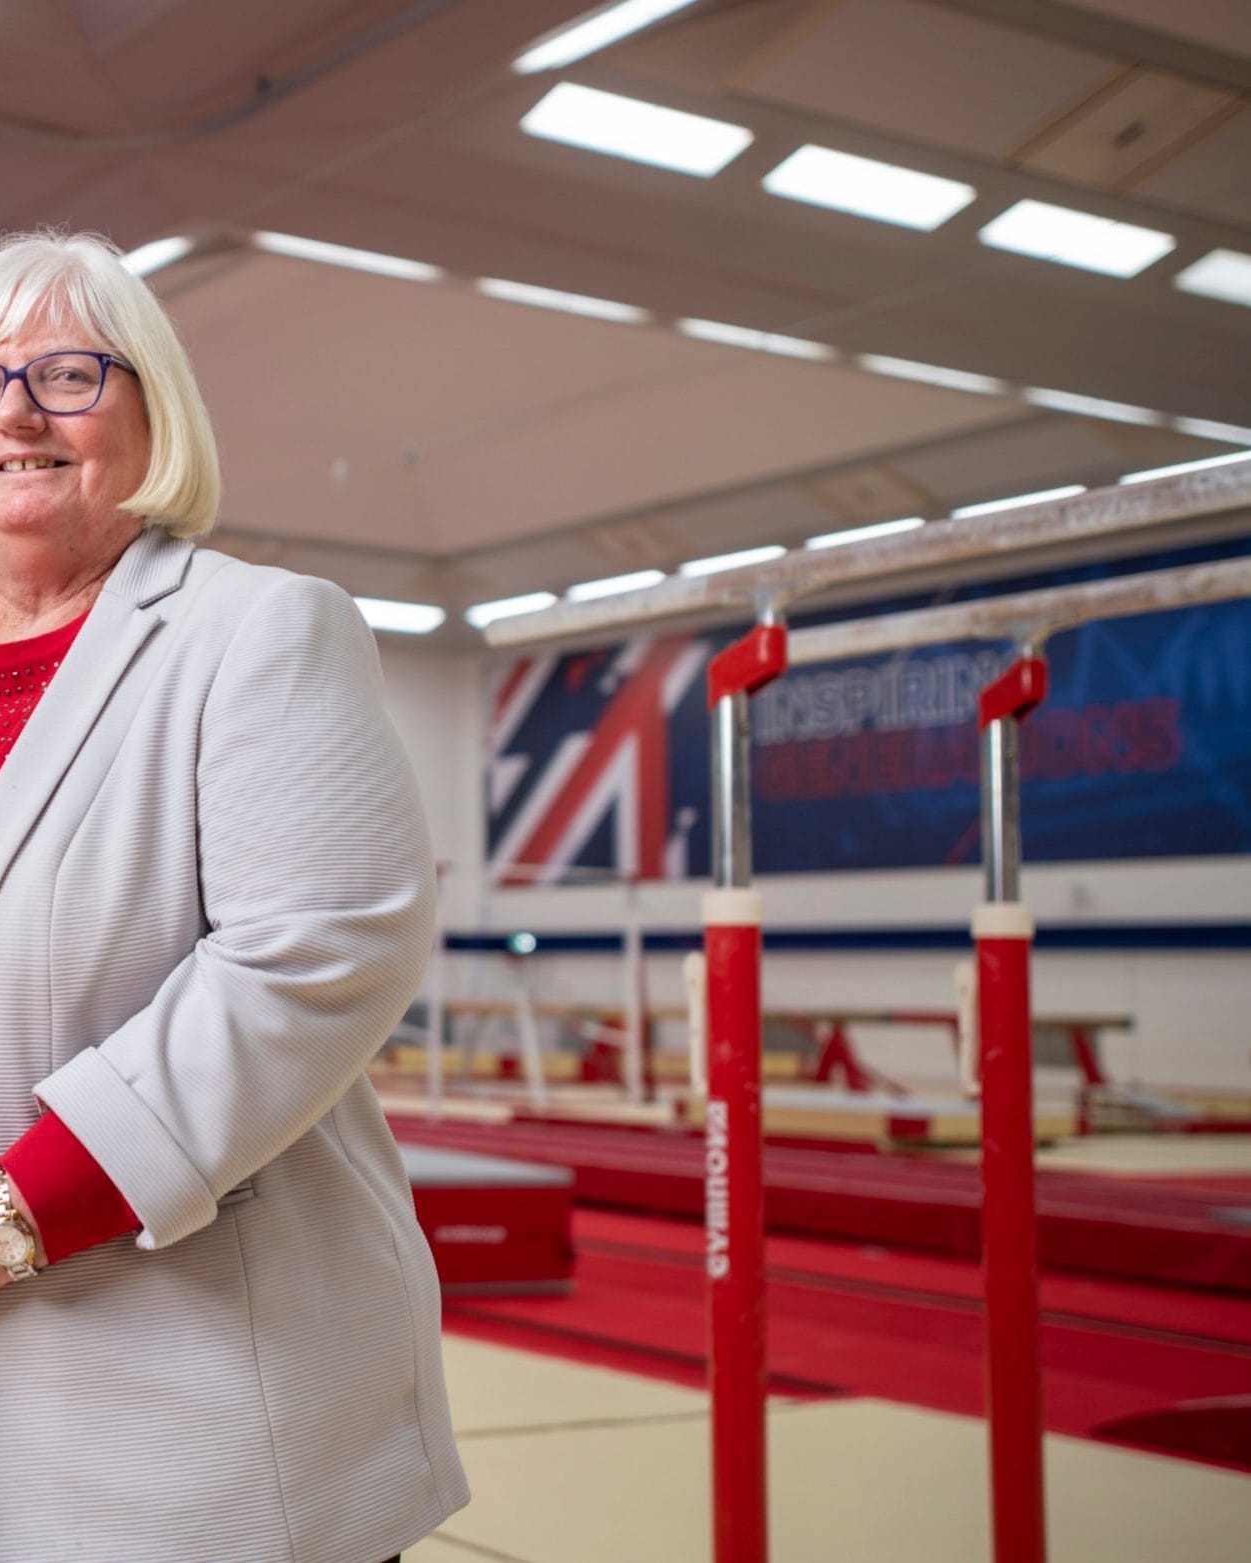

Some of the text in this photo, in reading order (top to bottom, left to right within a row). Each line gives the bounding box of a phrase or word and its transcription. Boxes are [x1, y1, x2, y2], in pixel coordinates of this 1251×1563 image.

[754, 650, 1006, 744] INSPIRIN
[754, 696, 1184, 802] GENERAIONS
[705, 1100, 730, 1279] GYMNOVA
